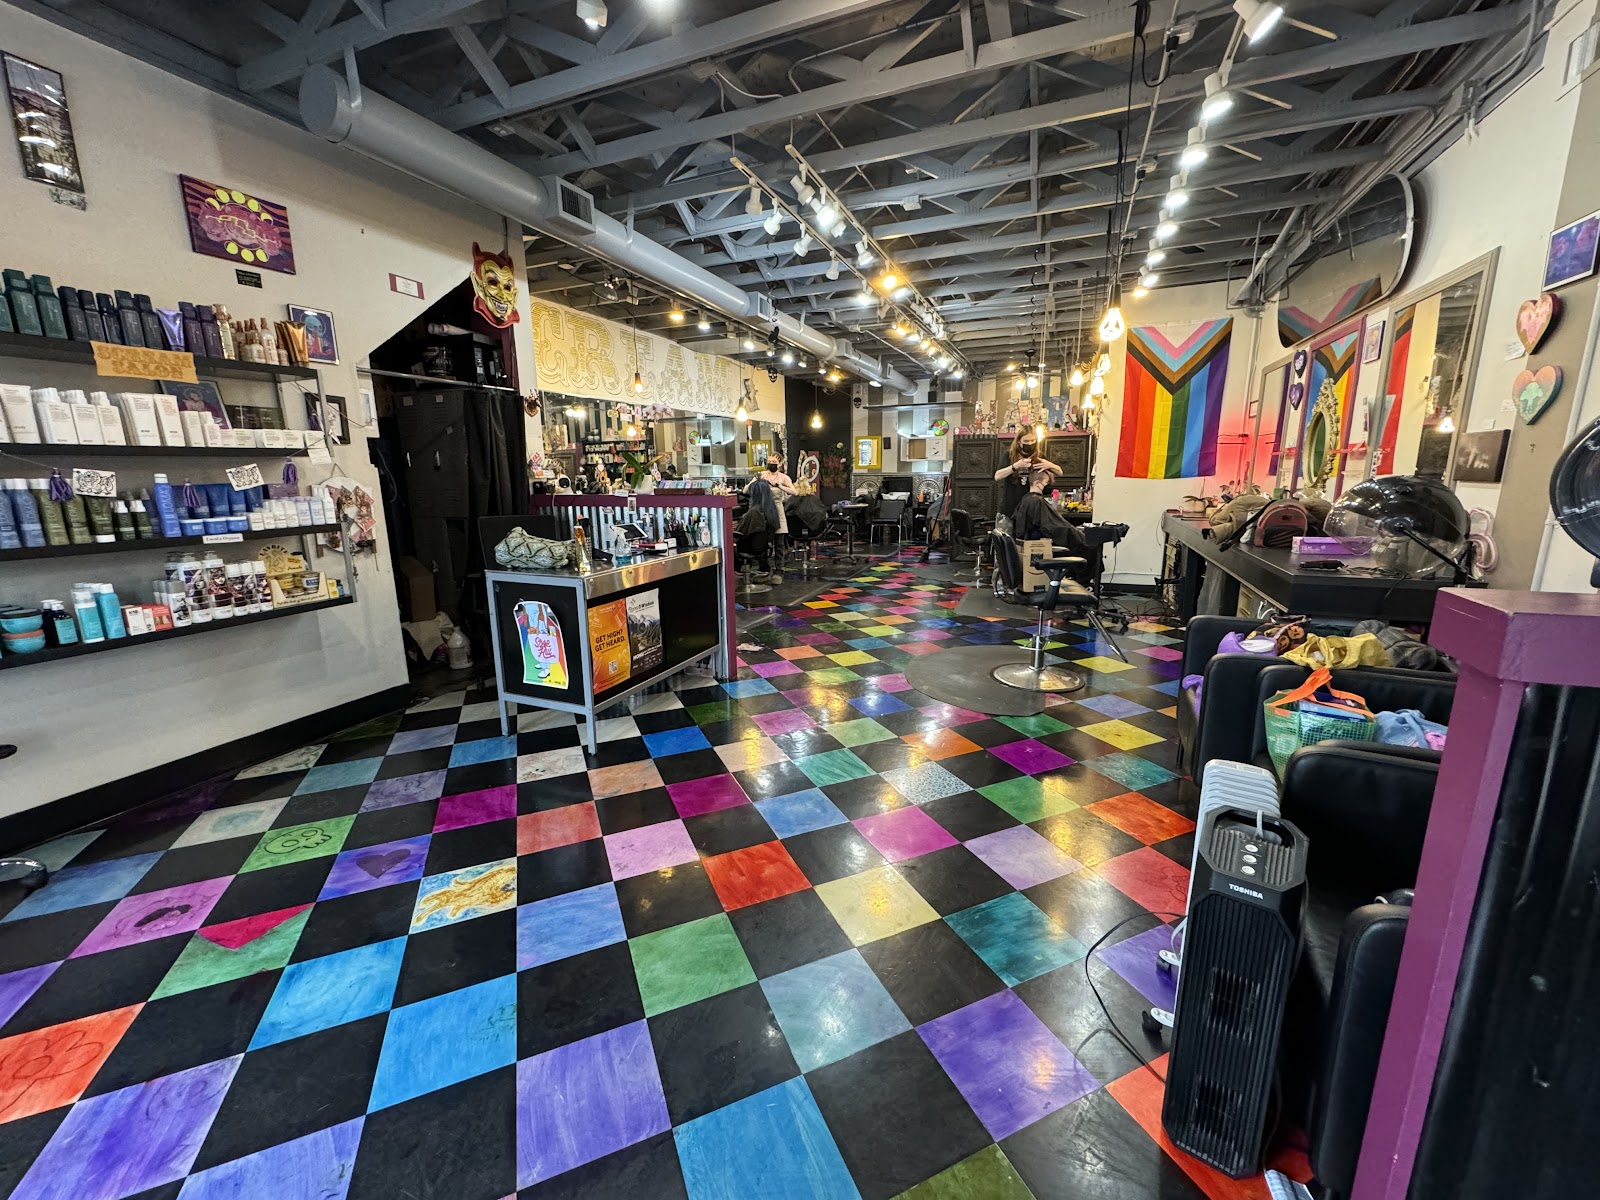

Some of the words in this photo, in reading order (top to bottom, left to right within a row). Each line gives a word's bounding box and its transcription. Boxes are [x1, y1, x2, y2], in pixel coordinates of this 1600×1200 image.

[112, 360, 183, 380] SALON
[595, 634, 606, 644] GET
[594, 642, 606, 652] GET
[1229, 883, 1263, 899] TOSHIBA
